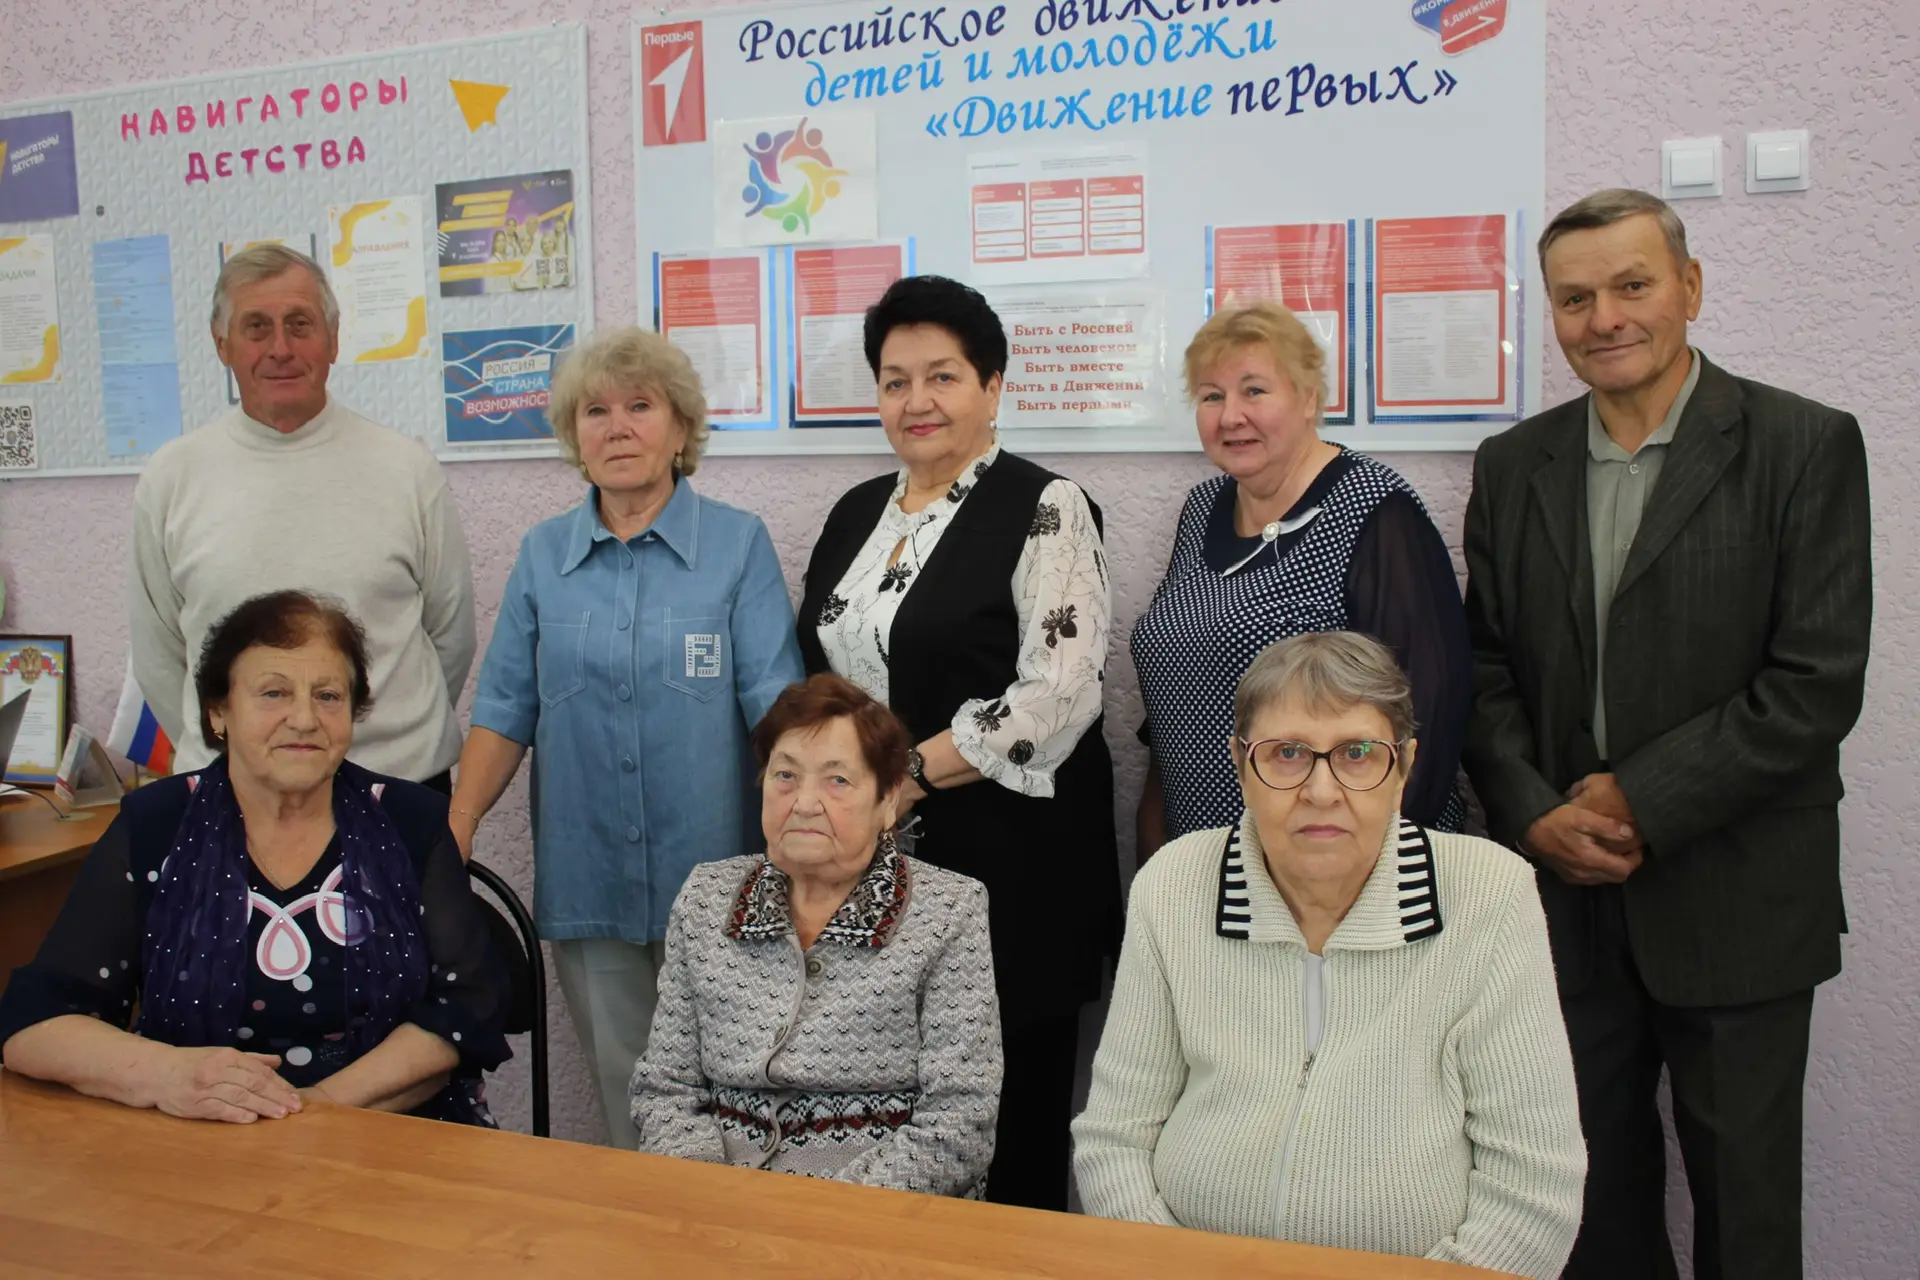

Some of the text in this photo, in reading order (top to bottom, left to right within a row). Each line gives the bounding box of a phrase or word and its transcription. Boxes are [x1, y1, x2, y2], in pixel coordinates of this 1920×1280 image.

[645, 31, 694, 48] Первые
[739, 3, 1007, 63] Российское
[805, 16, 1277, 107] детей и молодёжи
[121, 75, 408, 141] НАВИГАТОРЫ
[926, 83, 1213, 138] «Движение
[185, 136, 366, 185] ДЕТСТВА
[1014, 321, 1134, 337] Быть с Россией
[1011, 343, 1052, 355] Быть
[485, 358, 536, 377] РОССИЯ
[1024, 361, 1125, 373] Быть вместе
[495, 376, 545, 394] СТРАНА
[1005, 381, 1045, 393] Быть
[1050, 384, 1059, 392] в
[466, 392, 552, 415] ВОЗМОЖНОСТ
[1017, 400, 1057, 411] Быть
